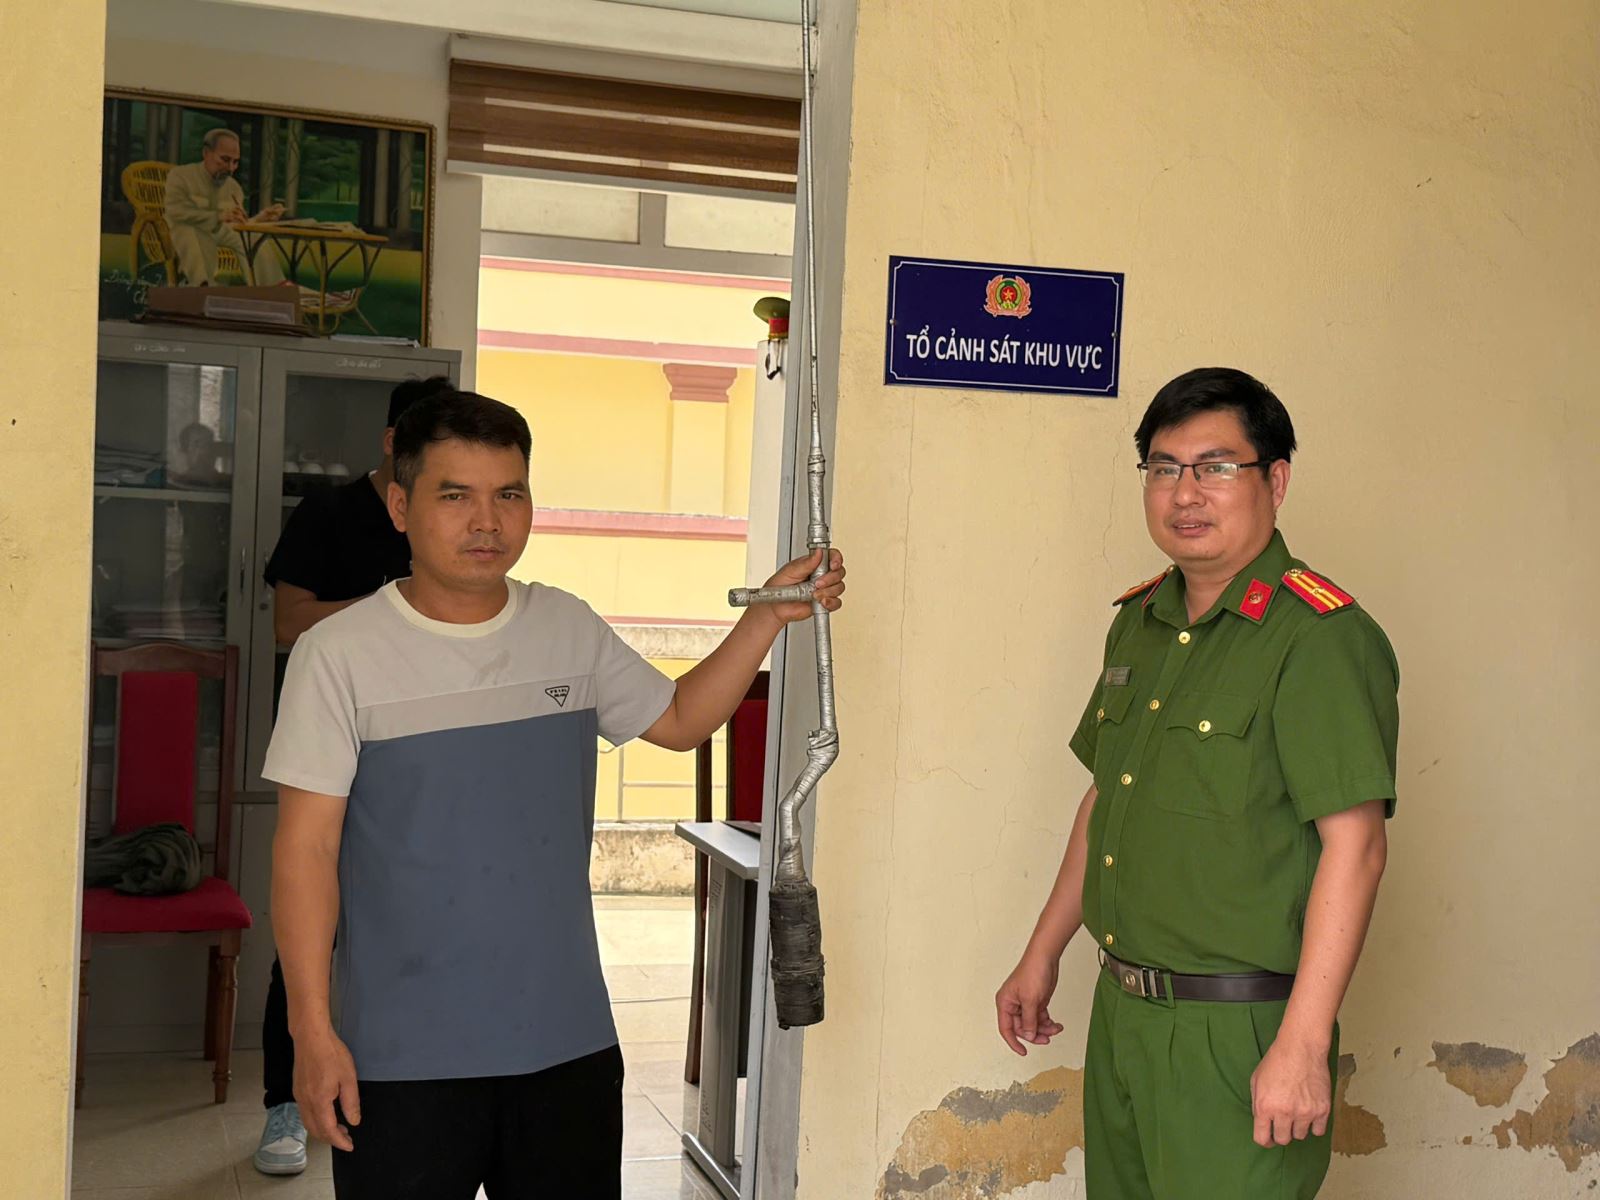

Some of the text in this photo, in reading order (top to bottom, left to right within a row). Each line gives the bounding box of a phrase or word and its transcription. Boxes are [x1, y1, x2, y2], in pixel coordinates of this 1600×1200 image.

[906, 325, 1103, 374] TỔ CẢNH SÁT KHU VỰC
